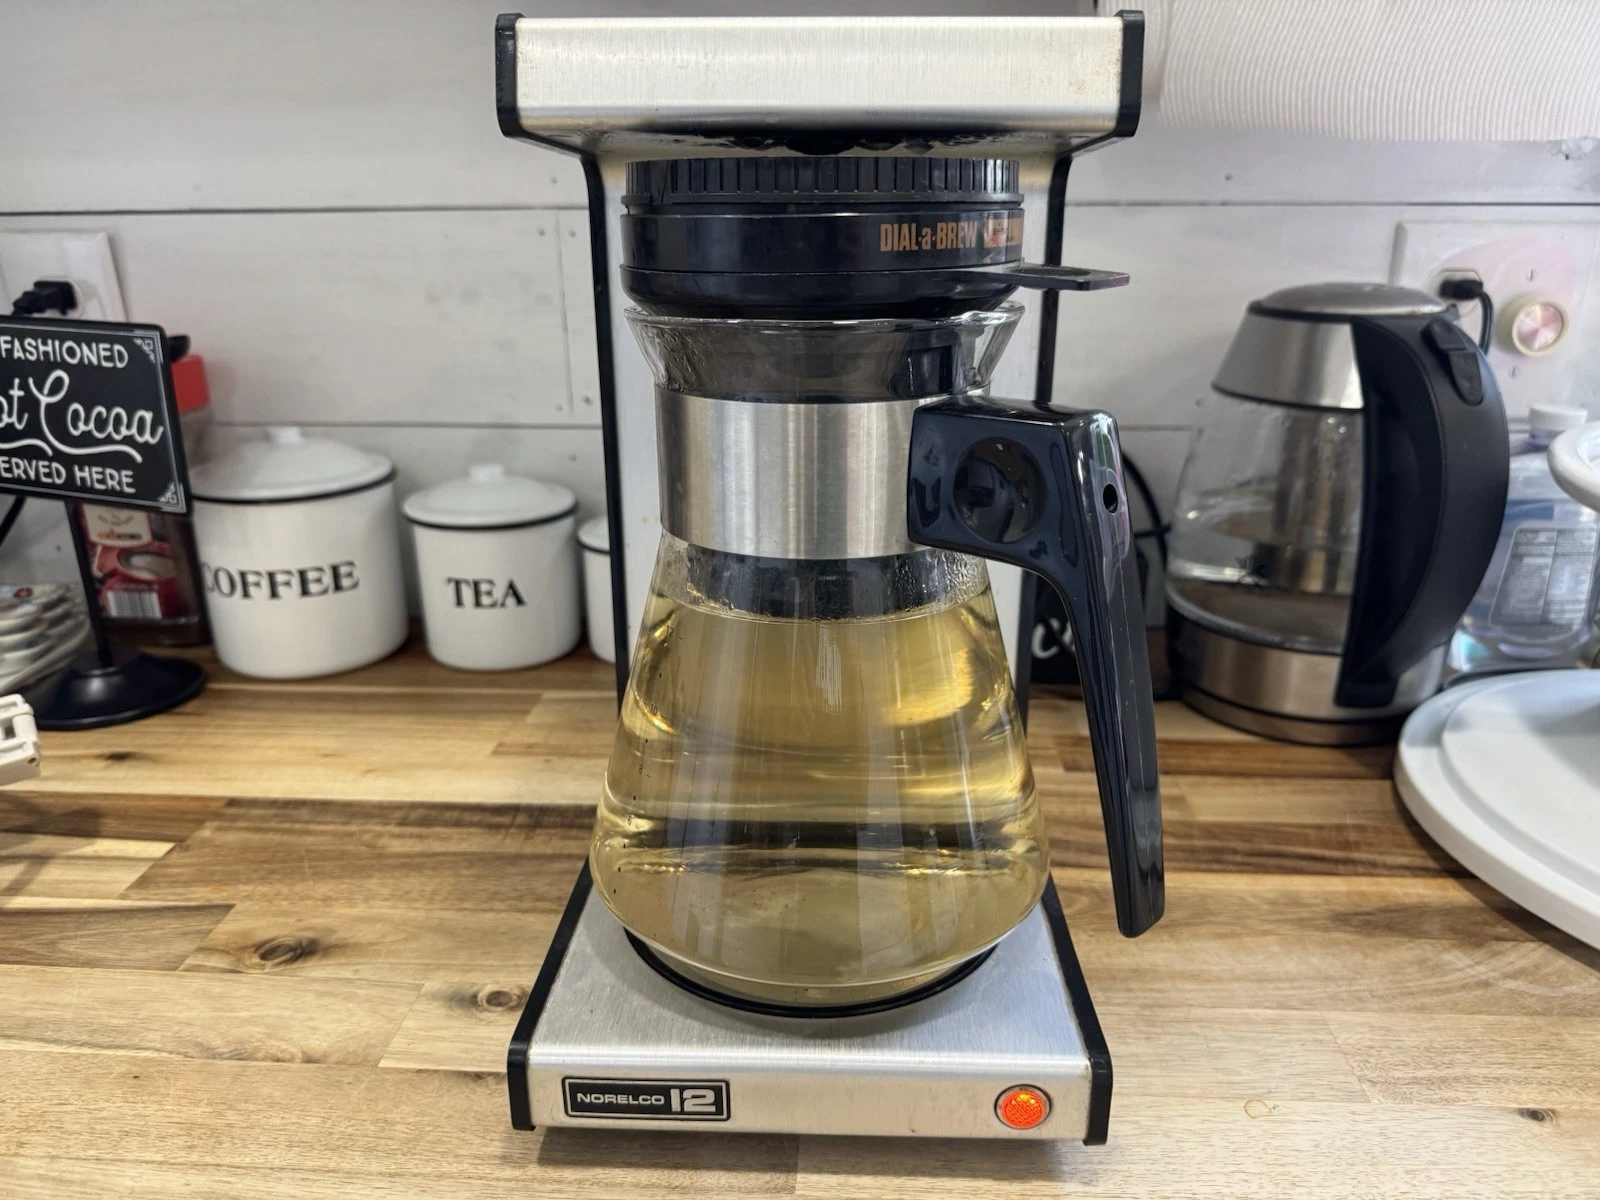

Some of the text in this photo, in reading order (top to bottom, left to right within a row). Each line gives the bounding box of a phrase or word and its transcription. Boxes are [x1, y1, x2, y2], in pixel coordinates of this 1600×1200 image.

[0, 335, 129, 368] FASHIONED
[28, 369, 164, 463] Cocoa
[73, 464, 137, 494] HERE
[445, 576, 528, 608] TEA
[576, 1088, 717, 1113] NORELCO 12
